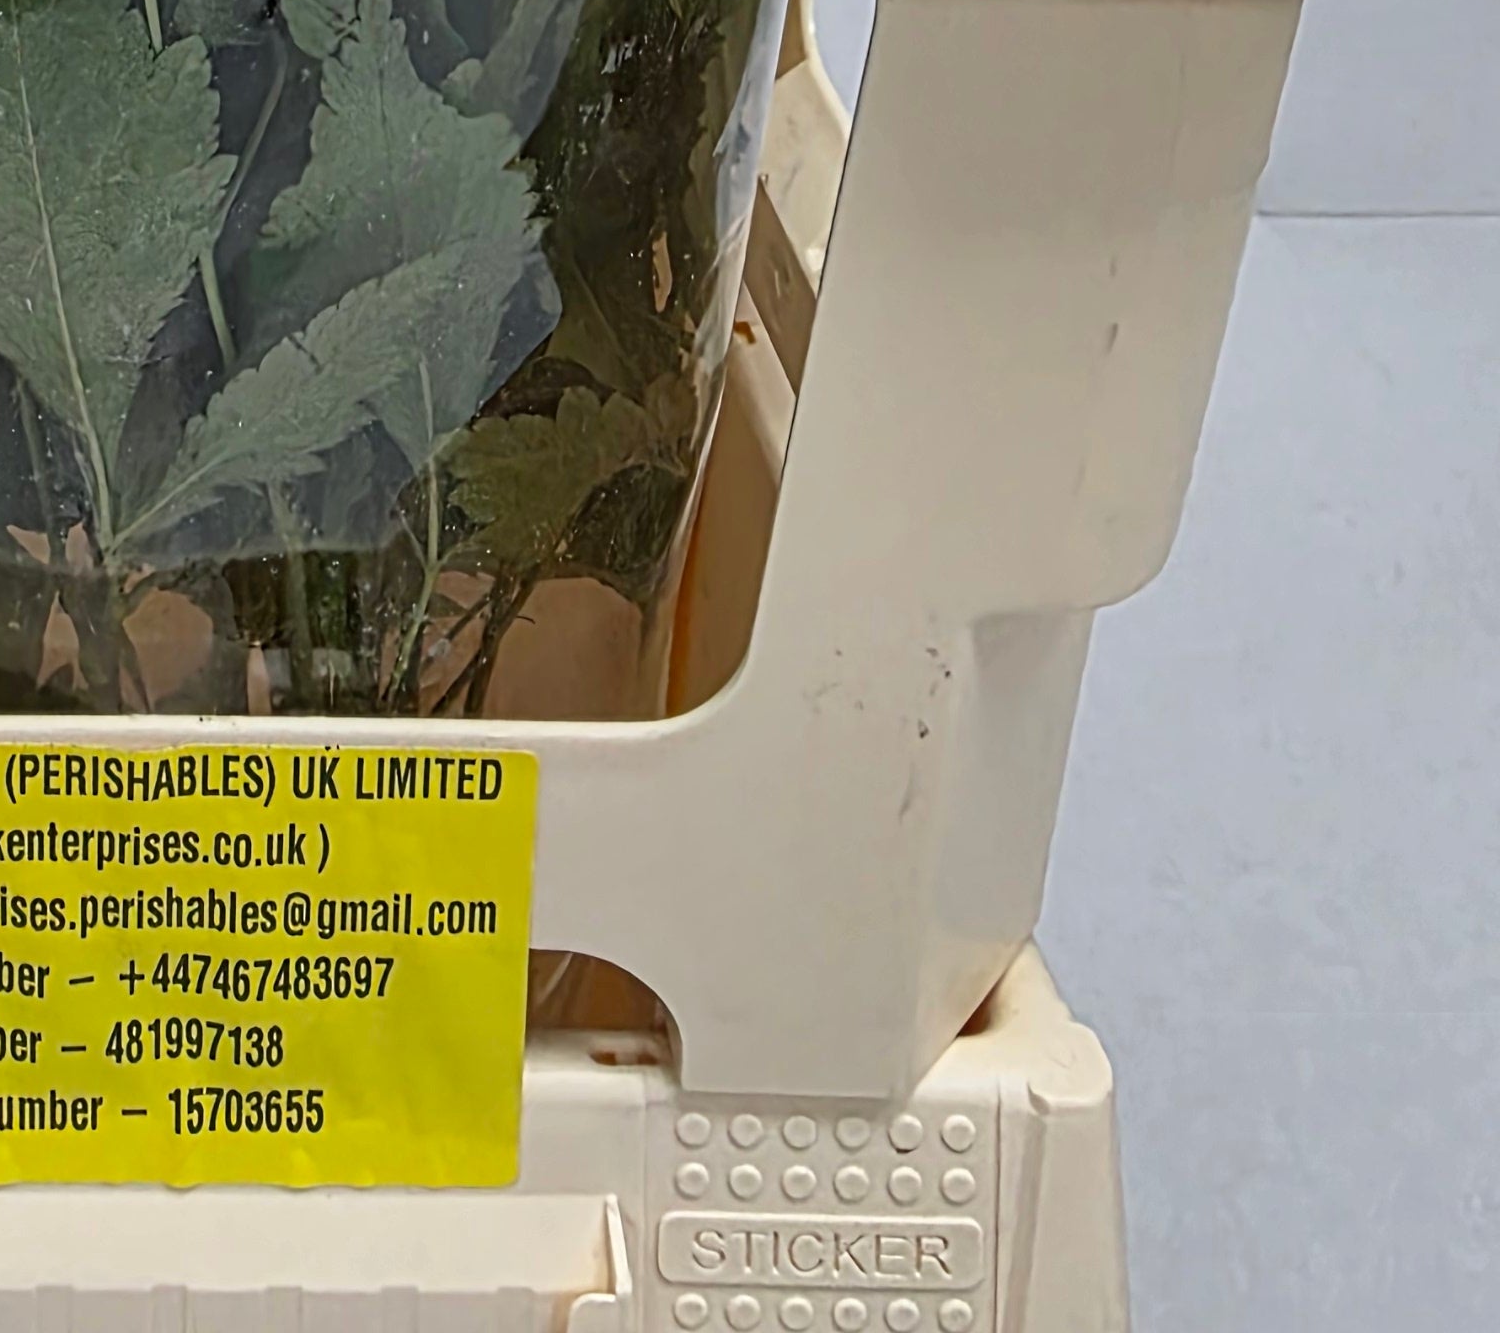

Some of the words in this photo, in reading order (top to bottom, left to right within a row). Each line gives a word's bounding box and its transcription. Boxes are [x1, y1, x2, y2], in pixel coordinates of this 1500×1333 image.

[6, 754, 275, 807] (PERISHABLES)
[293, 756, 340, 799] UK
[356, 757, 502, 800] LIMITED
[120, 953, 394, 1001] +447467483697
[106, 1017, 283, 1067] 481997138
[169, 1087, 323, 1134] 15703655
[692, 1230, 952, 1276] STICKER
